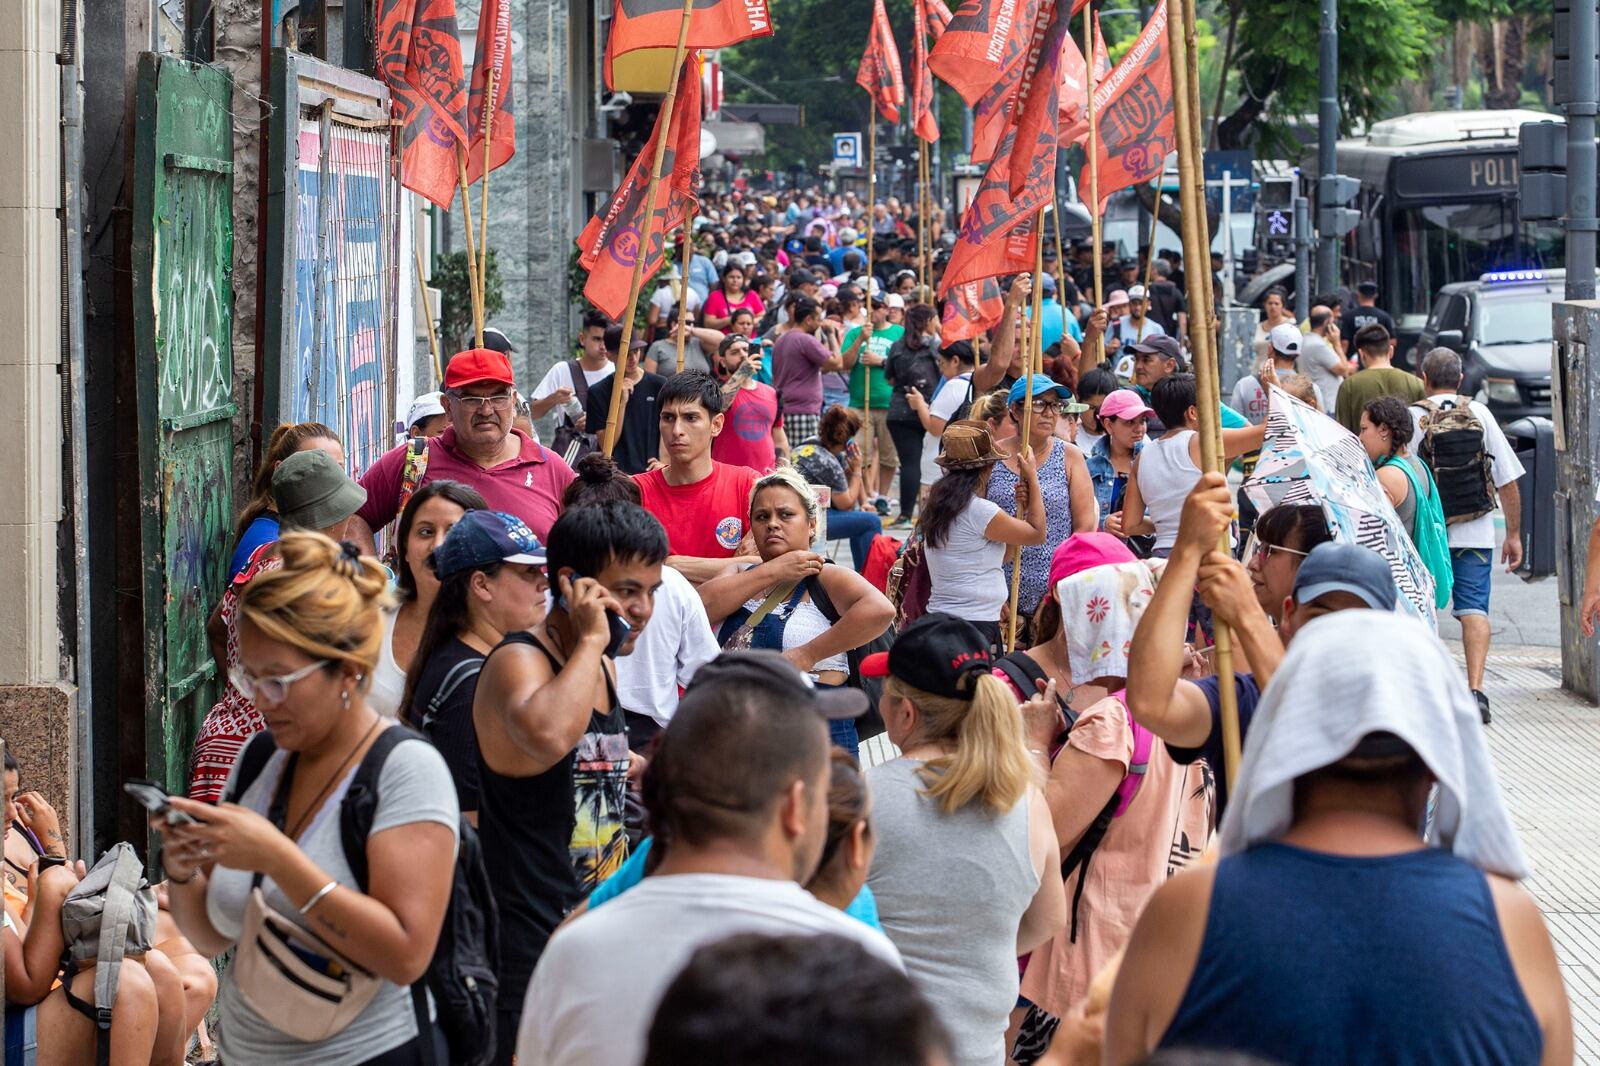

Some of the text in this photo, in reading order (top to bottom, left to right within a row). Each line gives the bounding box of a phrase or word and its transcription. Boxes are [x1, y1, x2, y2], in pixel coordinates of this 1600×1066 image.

[744, 0, 767, 31] CHA
[985, 28, 1009, 63] LUCHA
[1016, 32, 1045, 115] LUCHA
[1471, 158, 1519, 187] POLI
